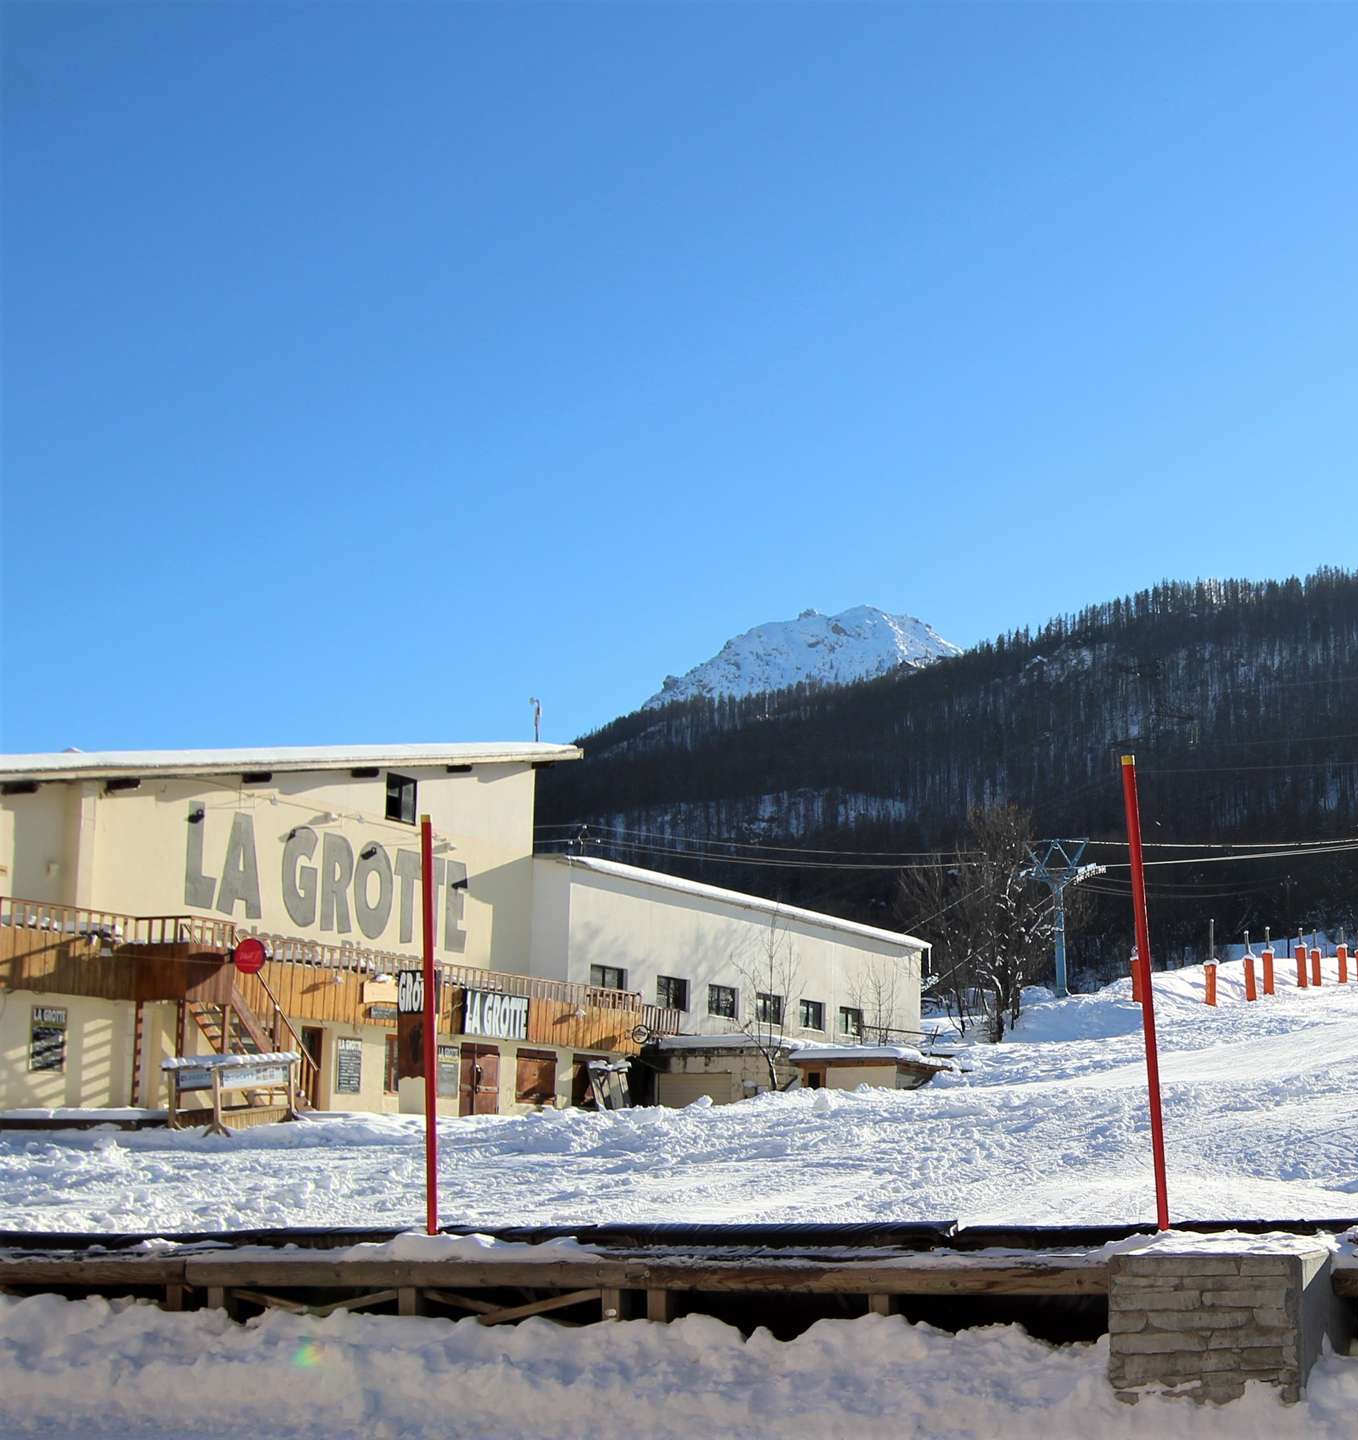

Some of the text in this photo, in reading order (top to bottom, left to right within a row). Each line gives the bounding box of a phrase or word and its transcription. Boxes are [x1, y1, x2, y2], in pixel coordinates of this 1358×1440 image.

[184, 800, 468, 954] LA GROTTE
[33, 1008, 42, 1021] LA
[466, 991, 529, 1039] LA GROTTE
